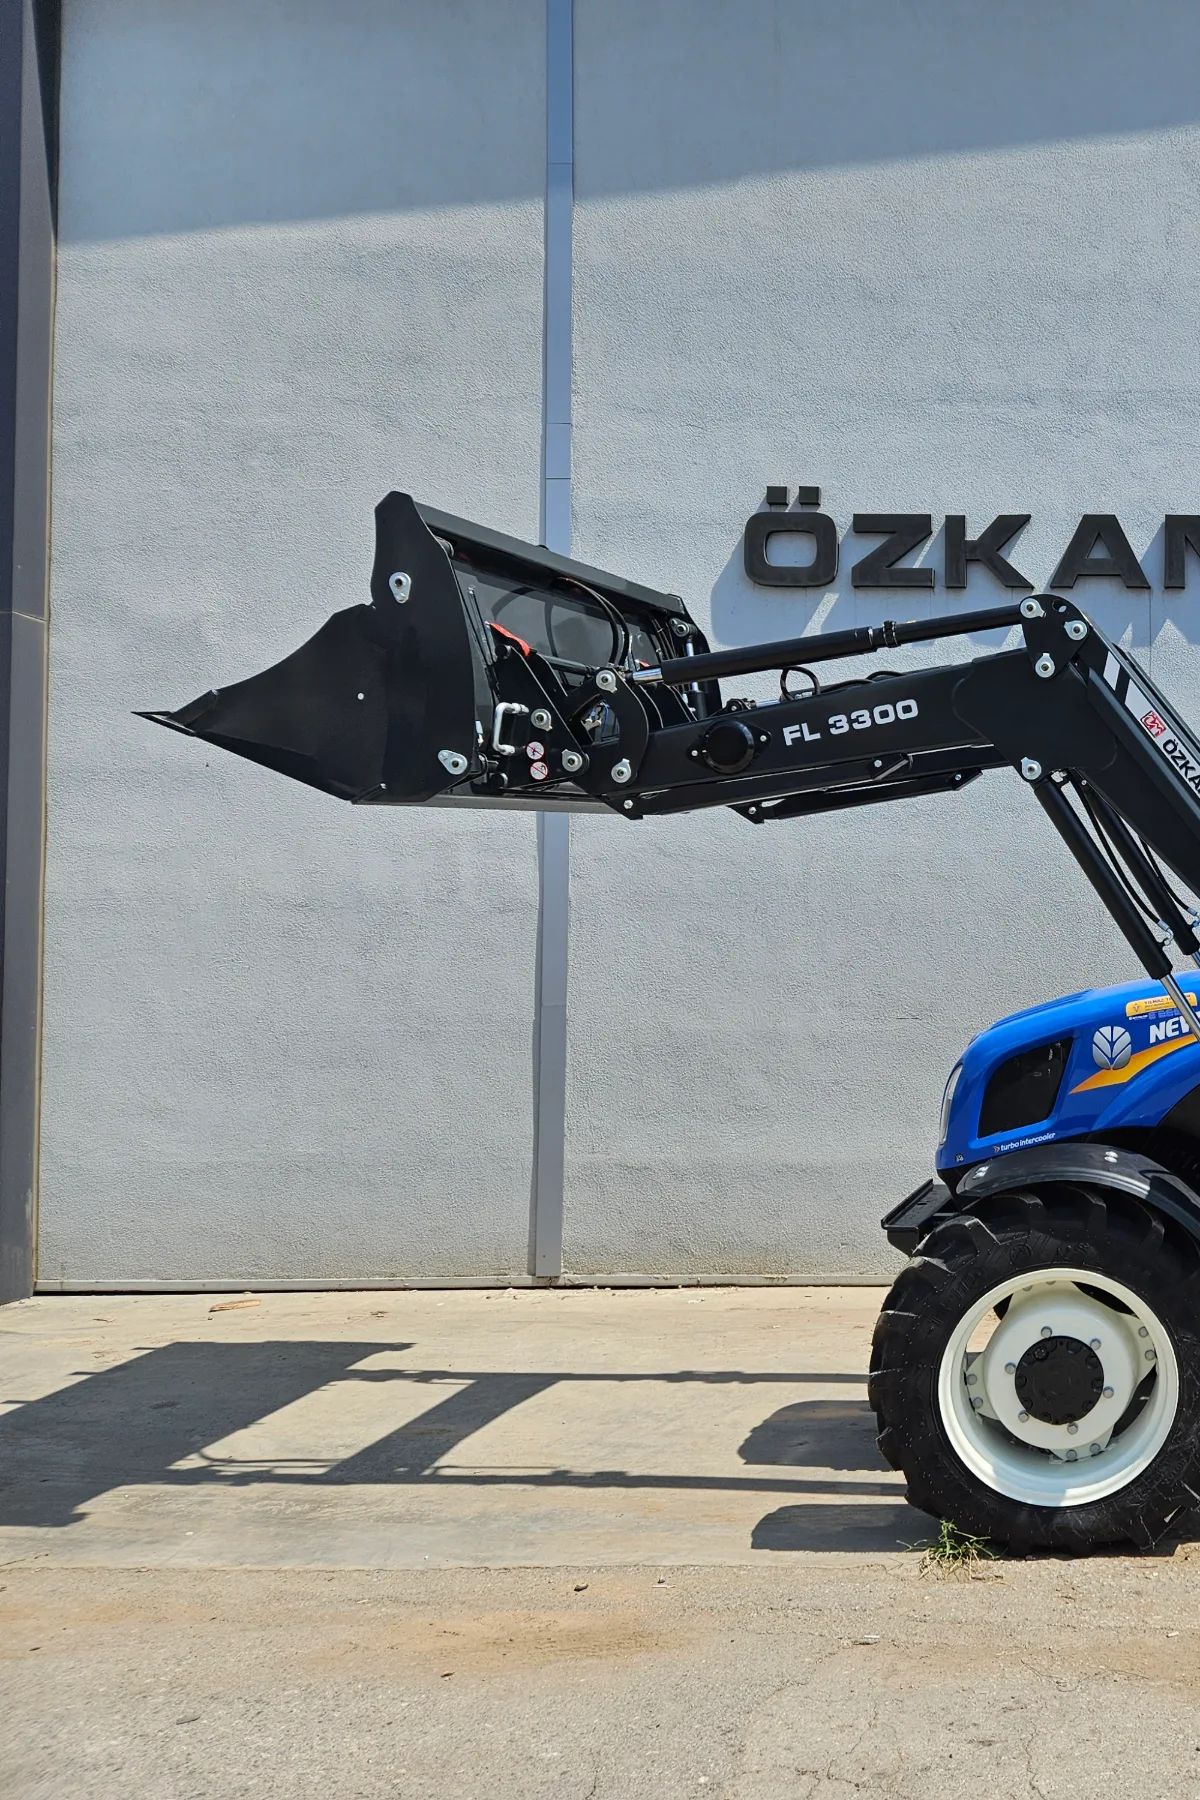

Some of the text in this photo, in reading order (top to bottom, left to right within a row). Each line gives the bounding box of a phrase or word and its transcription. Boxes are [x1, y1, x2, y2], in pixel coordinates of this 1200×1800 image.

[782, 698, 919, 746] FL 3300
[1000, 1132, 1056, 1151] turbo intercooler
